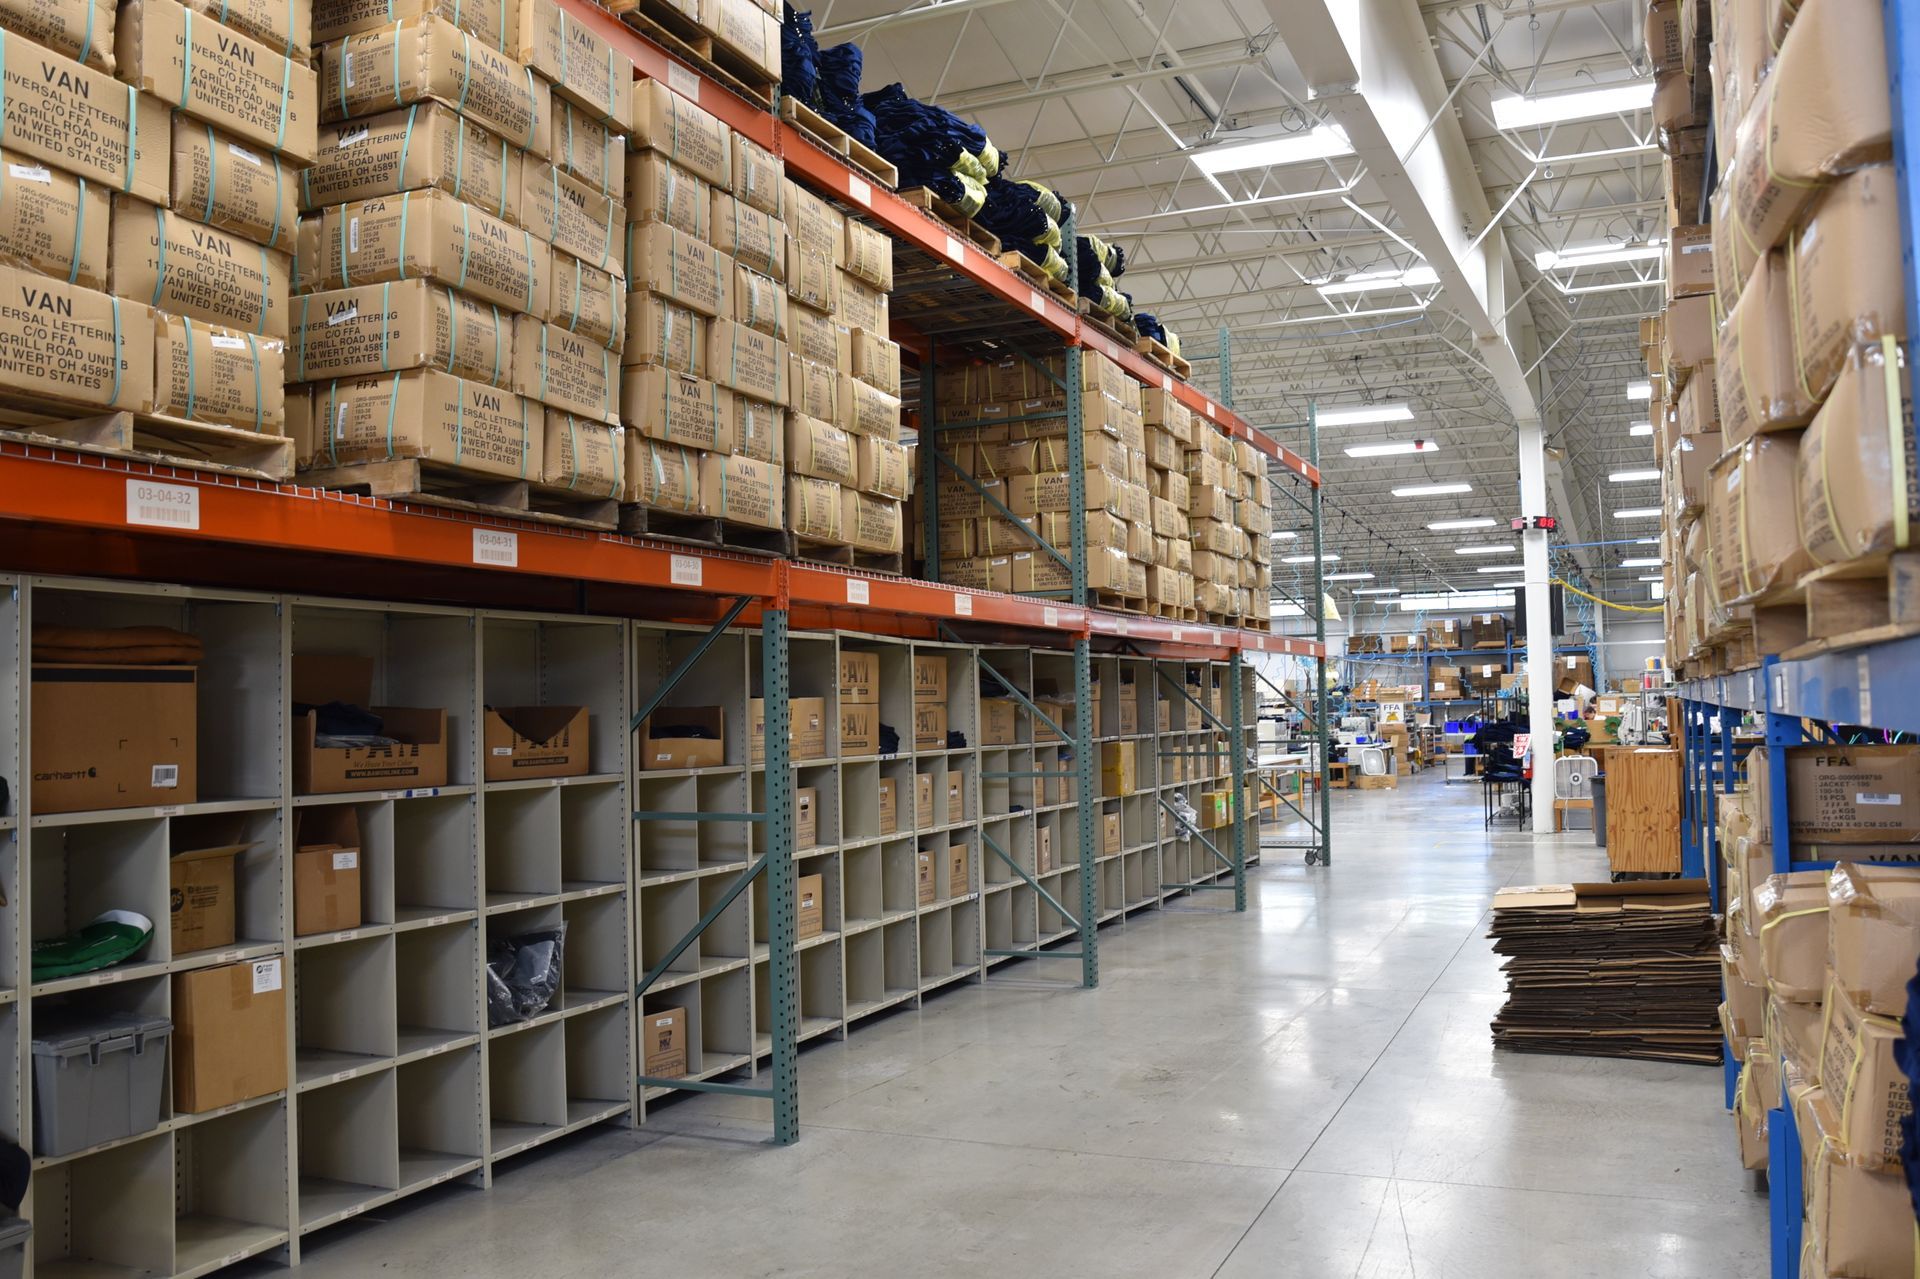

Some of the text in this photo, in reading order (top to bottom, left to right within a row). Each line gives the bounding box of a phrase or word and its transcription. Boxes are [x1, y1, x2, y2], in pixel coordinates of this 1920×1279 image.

[352, 6, 388, 21] STATES
[358, 34, 379, 45] FFA
[572, 26, 594, 53] VAN
[217, 34, 254, 67] VAN
[41, 62, 88, 98] VAN
[219, 65, 258, 92] C/O FFA
[200, 68, 296, 120] GRILL ROAD B
[210, 83, 257, 114] WERT OH
[20, 100, 59, 125] GRILL
[64, 118, 98, 141] ROAD
[43, 97, 92, 127] C/O FFA
[196, 90, 276, 133] UNITED STATES
[13, 124, 114, 174] UNITED STATES
[32, 117, 128, 166] WERT OH 45891
[321, 151, 400, 174] GRILL ROAD UNIT
[336, 148, 371, 162] C/O FFA
[329, 161, 398, 182] WERT OH 45891
[316, 173, 388, 194] UNITED STATES
[562, 184, 585, 209] VAN
[363, 203, 385, 214] FFA
[36, 231, 52, 241] KGS
[481, 220, 507, 244] VAN
[192, 229, 230, 258] VAN
[687, 243, 704, 262] VAN
[482, 246, 510, 265] C/O FFA
[194, 262, 234, 284] C/O FFA
[470, 251, 537, 286] GRILL ROAD B
[476, 263, 509, 284] WERT OH
[175, 267, 273, 307] GRILL ROAD B
[466, 269, 522, 299] UNITED STATES
[22, 286, 71, 316] VAN
[171, 290, 252, 323] UNITED STATES
[185, 281, 262, 315] WERT OH 45891
[325, 299, 359, 317] VAN
[24, 322, 76, 345] C/O FFA
[312, 331, 400, 350] GRILL ROAD B
[327, 326, 362, 338] C/O FFA
[320, 345, 361, 358] WERT OH
[562, 337, 584, 359] VAN
[748, 336, 763, 351] VAN
[13, 345, 114, 379] WERT OH 45891
[46, 340, 83, 359] ROAD
[120, 359, 128, 370] B
[309, 353, 379, 370] UNITED STATES
[49, 367, 100, 389] STATES
[356, 380, 378, 390] FFA
[680, 383, 700, 399] VAN
[473, 392, 500, 412] VAN
[463, 427, 506, 444] GRILL ROAD
[475, 420, 503, 434] C/O FFA
[470, 437, 491, 450] WERT
[493, 443, 503, 452] OH
[489, 452, 515, 465] STATES
[738, 464, 755, 477] VAN
[138, 488, 191, 504] 03-04-32
[1816, 757, 1850, 766] FFA
[34, 771, 86, 780] carhartt
